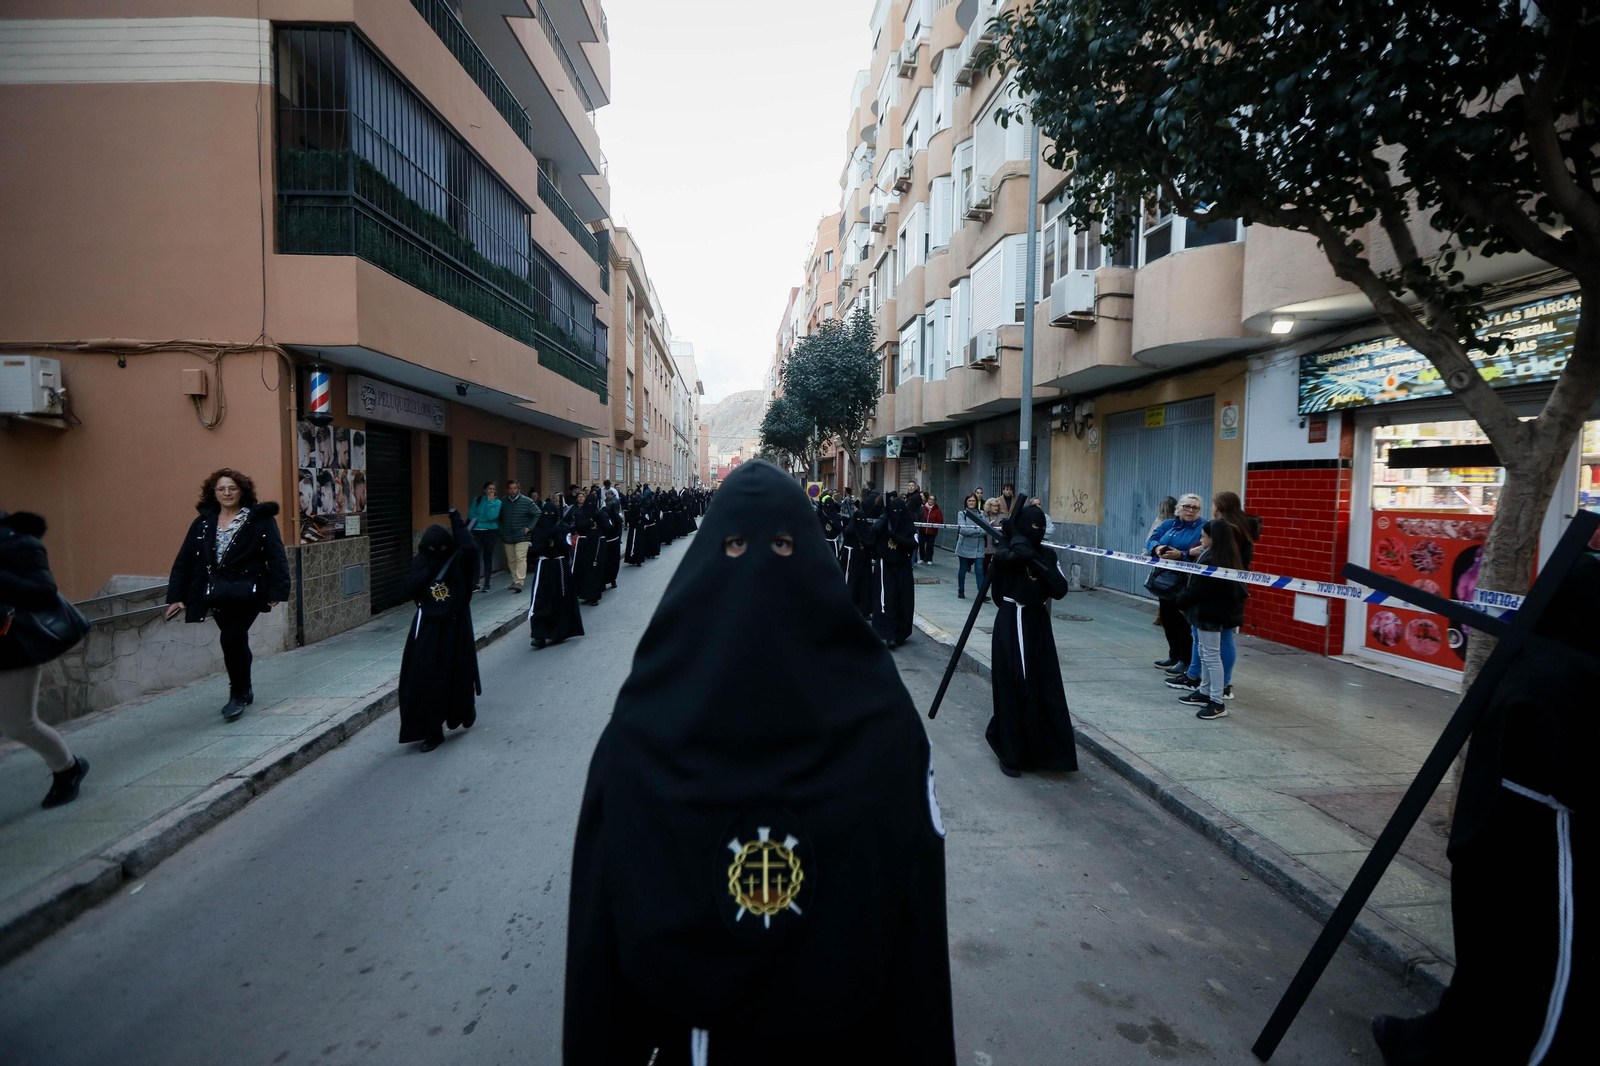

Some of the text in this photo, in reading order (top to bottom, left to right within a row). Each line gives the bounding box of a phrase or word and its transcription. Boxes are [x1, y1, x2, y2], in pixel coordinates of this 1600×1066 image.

[1495, 310, 1521, 326] LAS
[1317, 337, 1400, 364] REPARACIONES DE
[1328, 359, 1369, 375] PANTALLAS
[1316, 582, 1362, 598] POLICIA LOCAL
